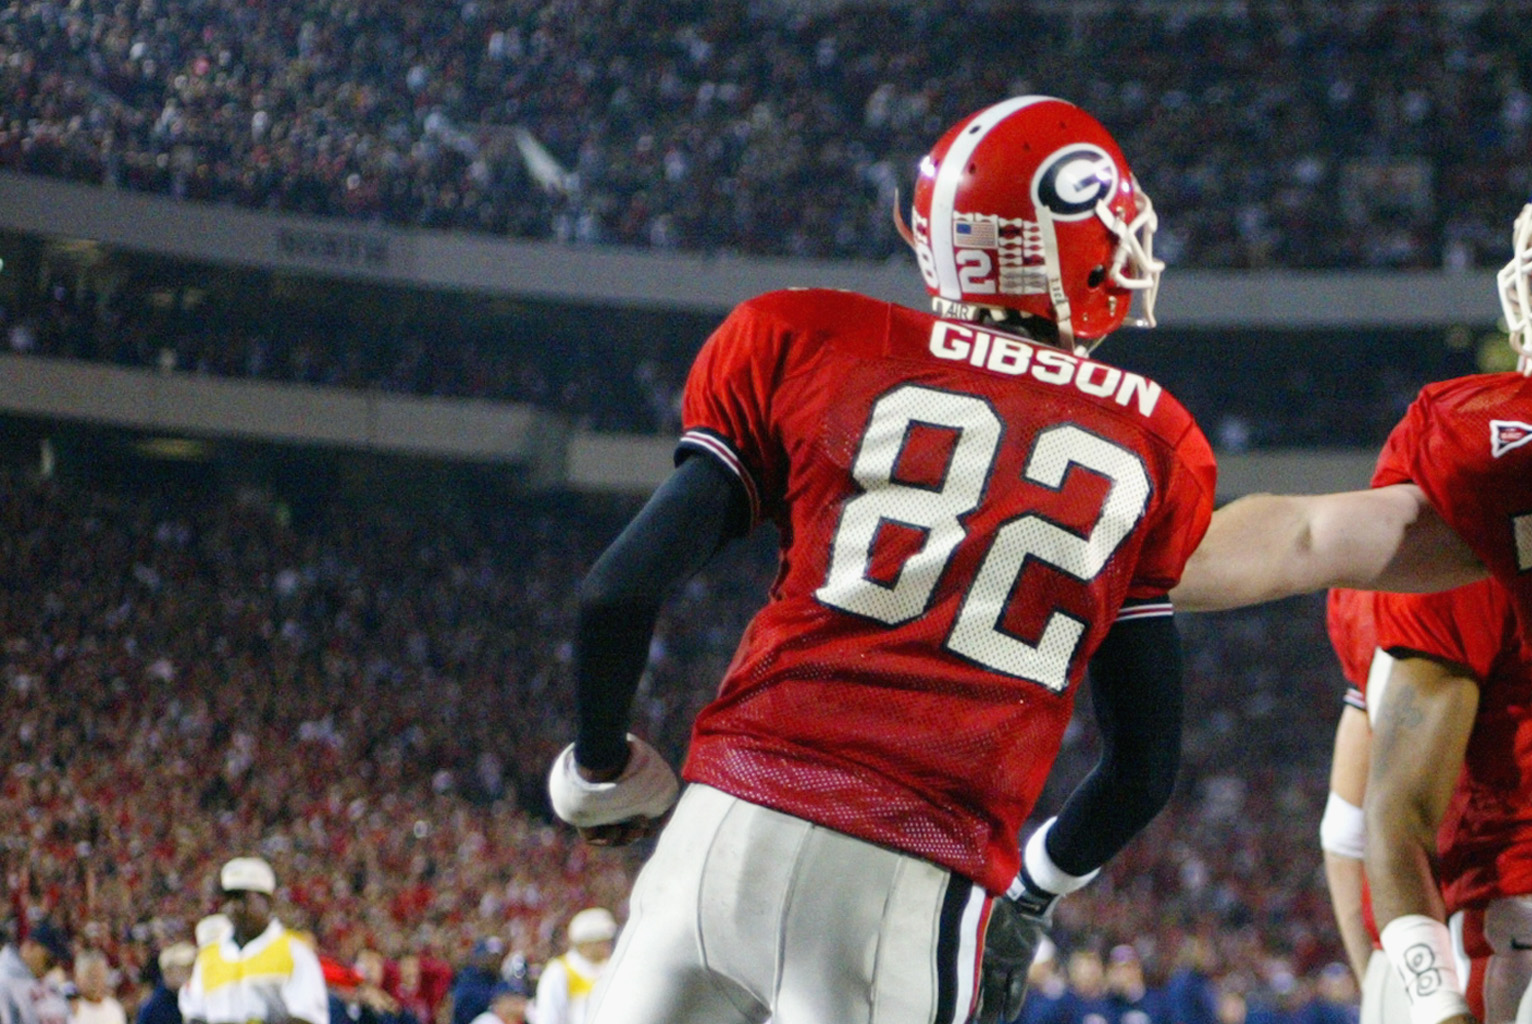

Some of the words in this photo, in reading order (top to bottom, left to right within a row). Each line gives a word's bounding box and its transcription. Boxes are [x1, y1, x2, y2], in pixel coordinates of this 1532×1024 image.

[1036, 149, 1113, 216] G
[928, 320, 1161, 417] GIBSON
[815, 384, 1154, 693] 82
